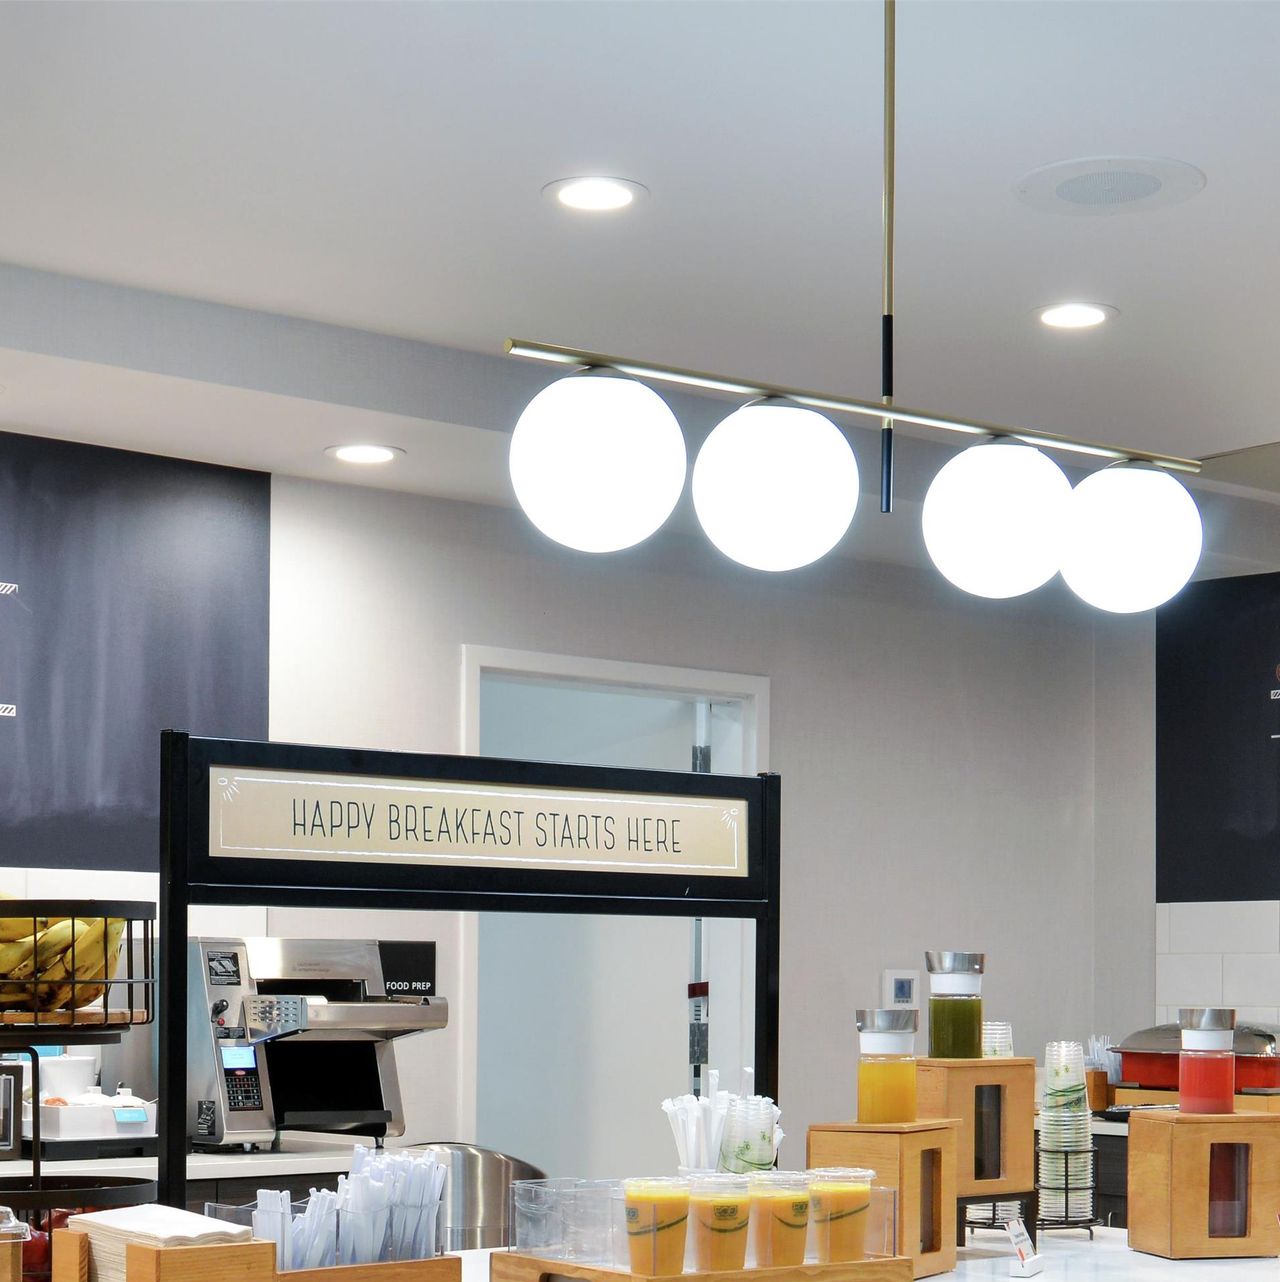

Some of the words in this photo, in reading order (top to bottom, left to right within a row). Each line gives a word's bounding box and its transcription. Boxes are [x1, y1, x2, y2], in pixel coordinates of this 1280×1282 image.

[292, 798, 376, 840] HAPPY
[388, 803, 525, 846] BREAKFAST
[535, 811, 616, 850] STARTS
[627, 817, 682, 853] HERE
[386, 981, 410, 990] FOOD
[411, 981, 431, 990] PREP
